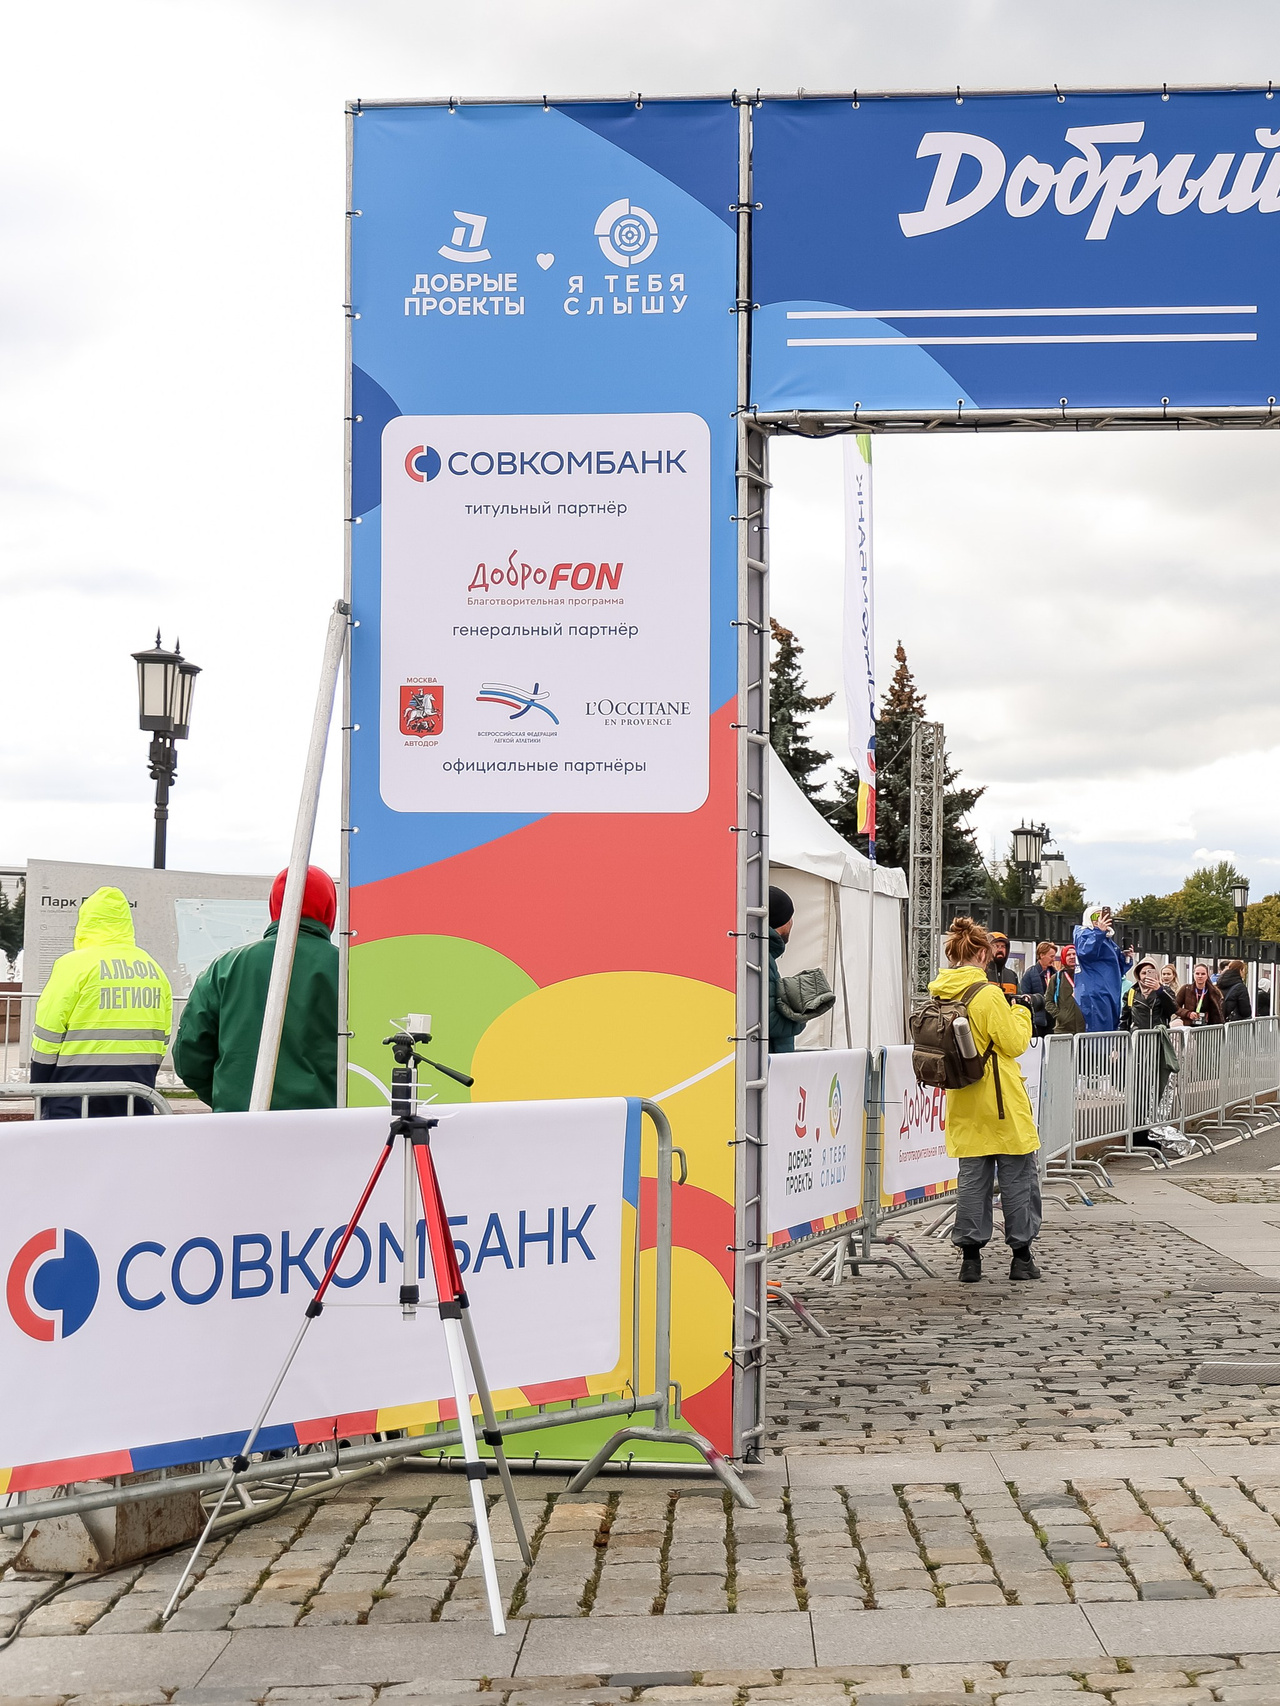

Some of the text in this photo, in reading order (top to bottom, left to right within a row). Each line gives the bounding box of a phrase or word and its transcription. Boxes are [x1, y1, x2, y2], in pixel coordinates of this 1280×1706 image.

[412, 273, 518, 294] ДОБРЫЕ
[568, 273, 686, 294] Я ТЕБЯ
[404, 296, 525, 316] ПРОЕКТЫ
[563, 294, 688, 316] СЛЫШУ
[447, 450, 688, 476] СОВКОМБАНК
[465, 501, 628, 517] титульный партнёр
[467, 596, 625, 608] Благотворительная программа
[453, 622, 639, 638] генеральный партнёр
[604, 718, 672, 726] EN PROVENCE
[404, 740, 439, 748] АВТОДОР
[442, 758, 647, 774] официальные партнёры
[41, 896, 77, 909] Парк
[100, 959, 159, 980] АЛЬФА
[99, 987, 161, 1010] ЛЕГИОН
[788, 1148, 812, 1174] ДОБРЫЕ
[830, 1144, 847, 1164] ТЕБЯ
[785, 1171, 814, 1196] ПРОЕКТЫ
[820, 1165, 847, 1188] СЛЫШУ
